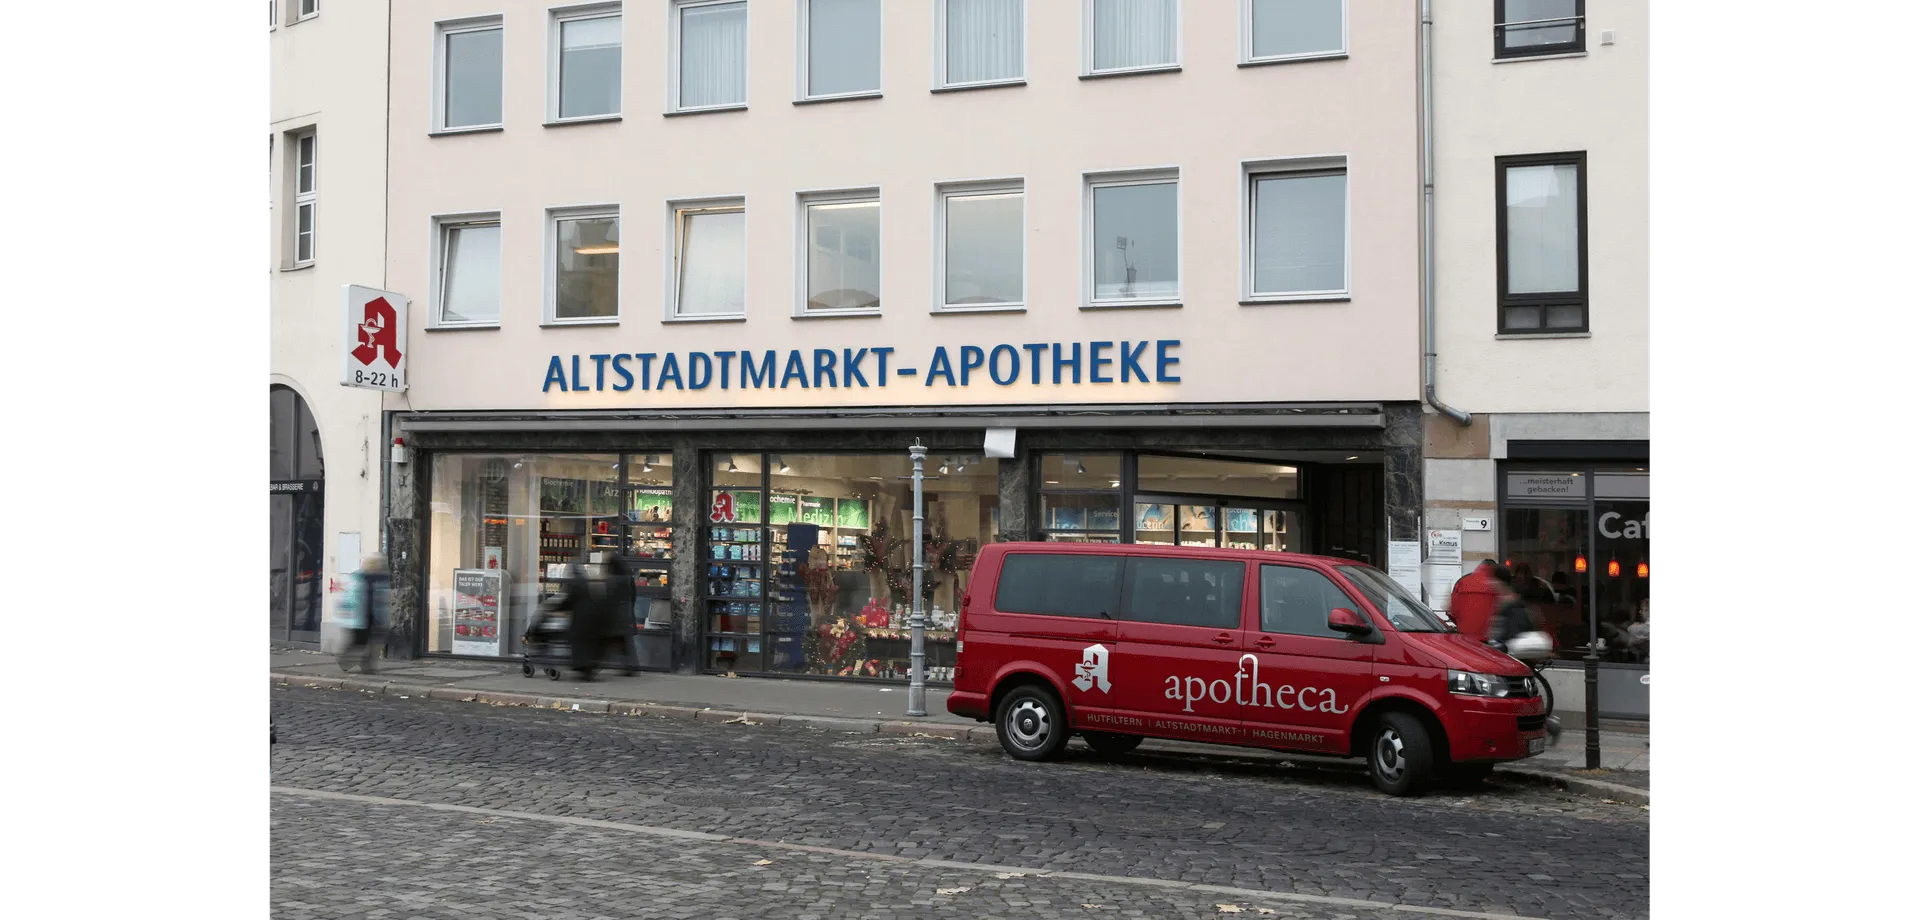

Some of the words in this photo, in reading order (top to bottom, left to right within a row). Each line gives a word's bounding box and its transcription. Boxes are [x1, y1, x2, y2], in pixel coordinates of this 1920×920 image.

[391, 374, 398, 388] h
[1527, 486, 1569, 494] gebacken!
[770, 495, 796, 504] ochemie
[1093, 510, 1118, 518] Service
[1136, 520, 1164, 529] ucerin
[1481, 519, 1488, 529] 9
[1164, 654, 1349, 714] apotheca
[1087, 713, 1143, 726] HUTFILTERN
[1252, 729, 1325, 744] HAGENMARKT
